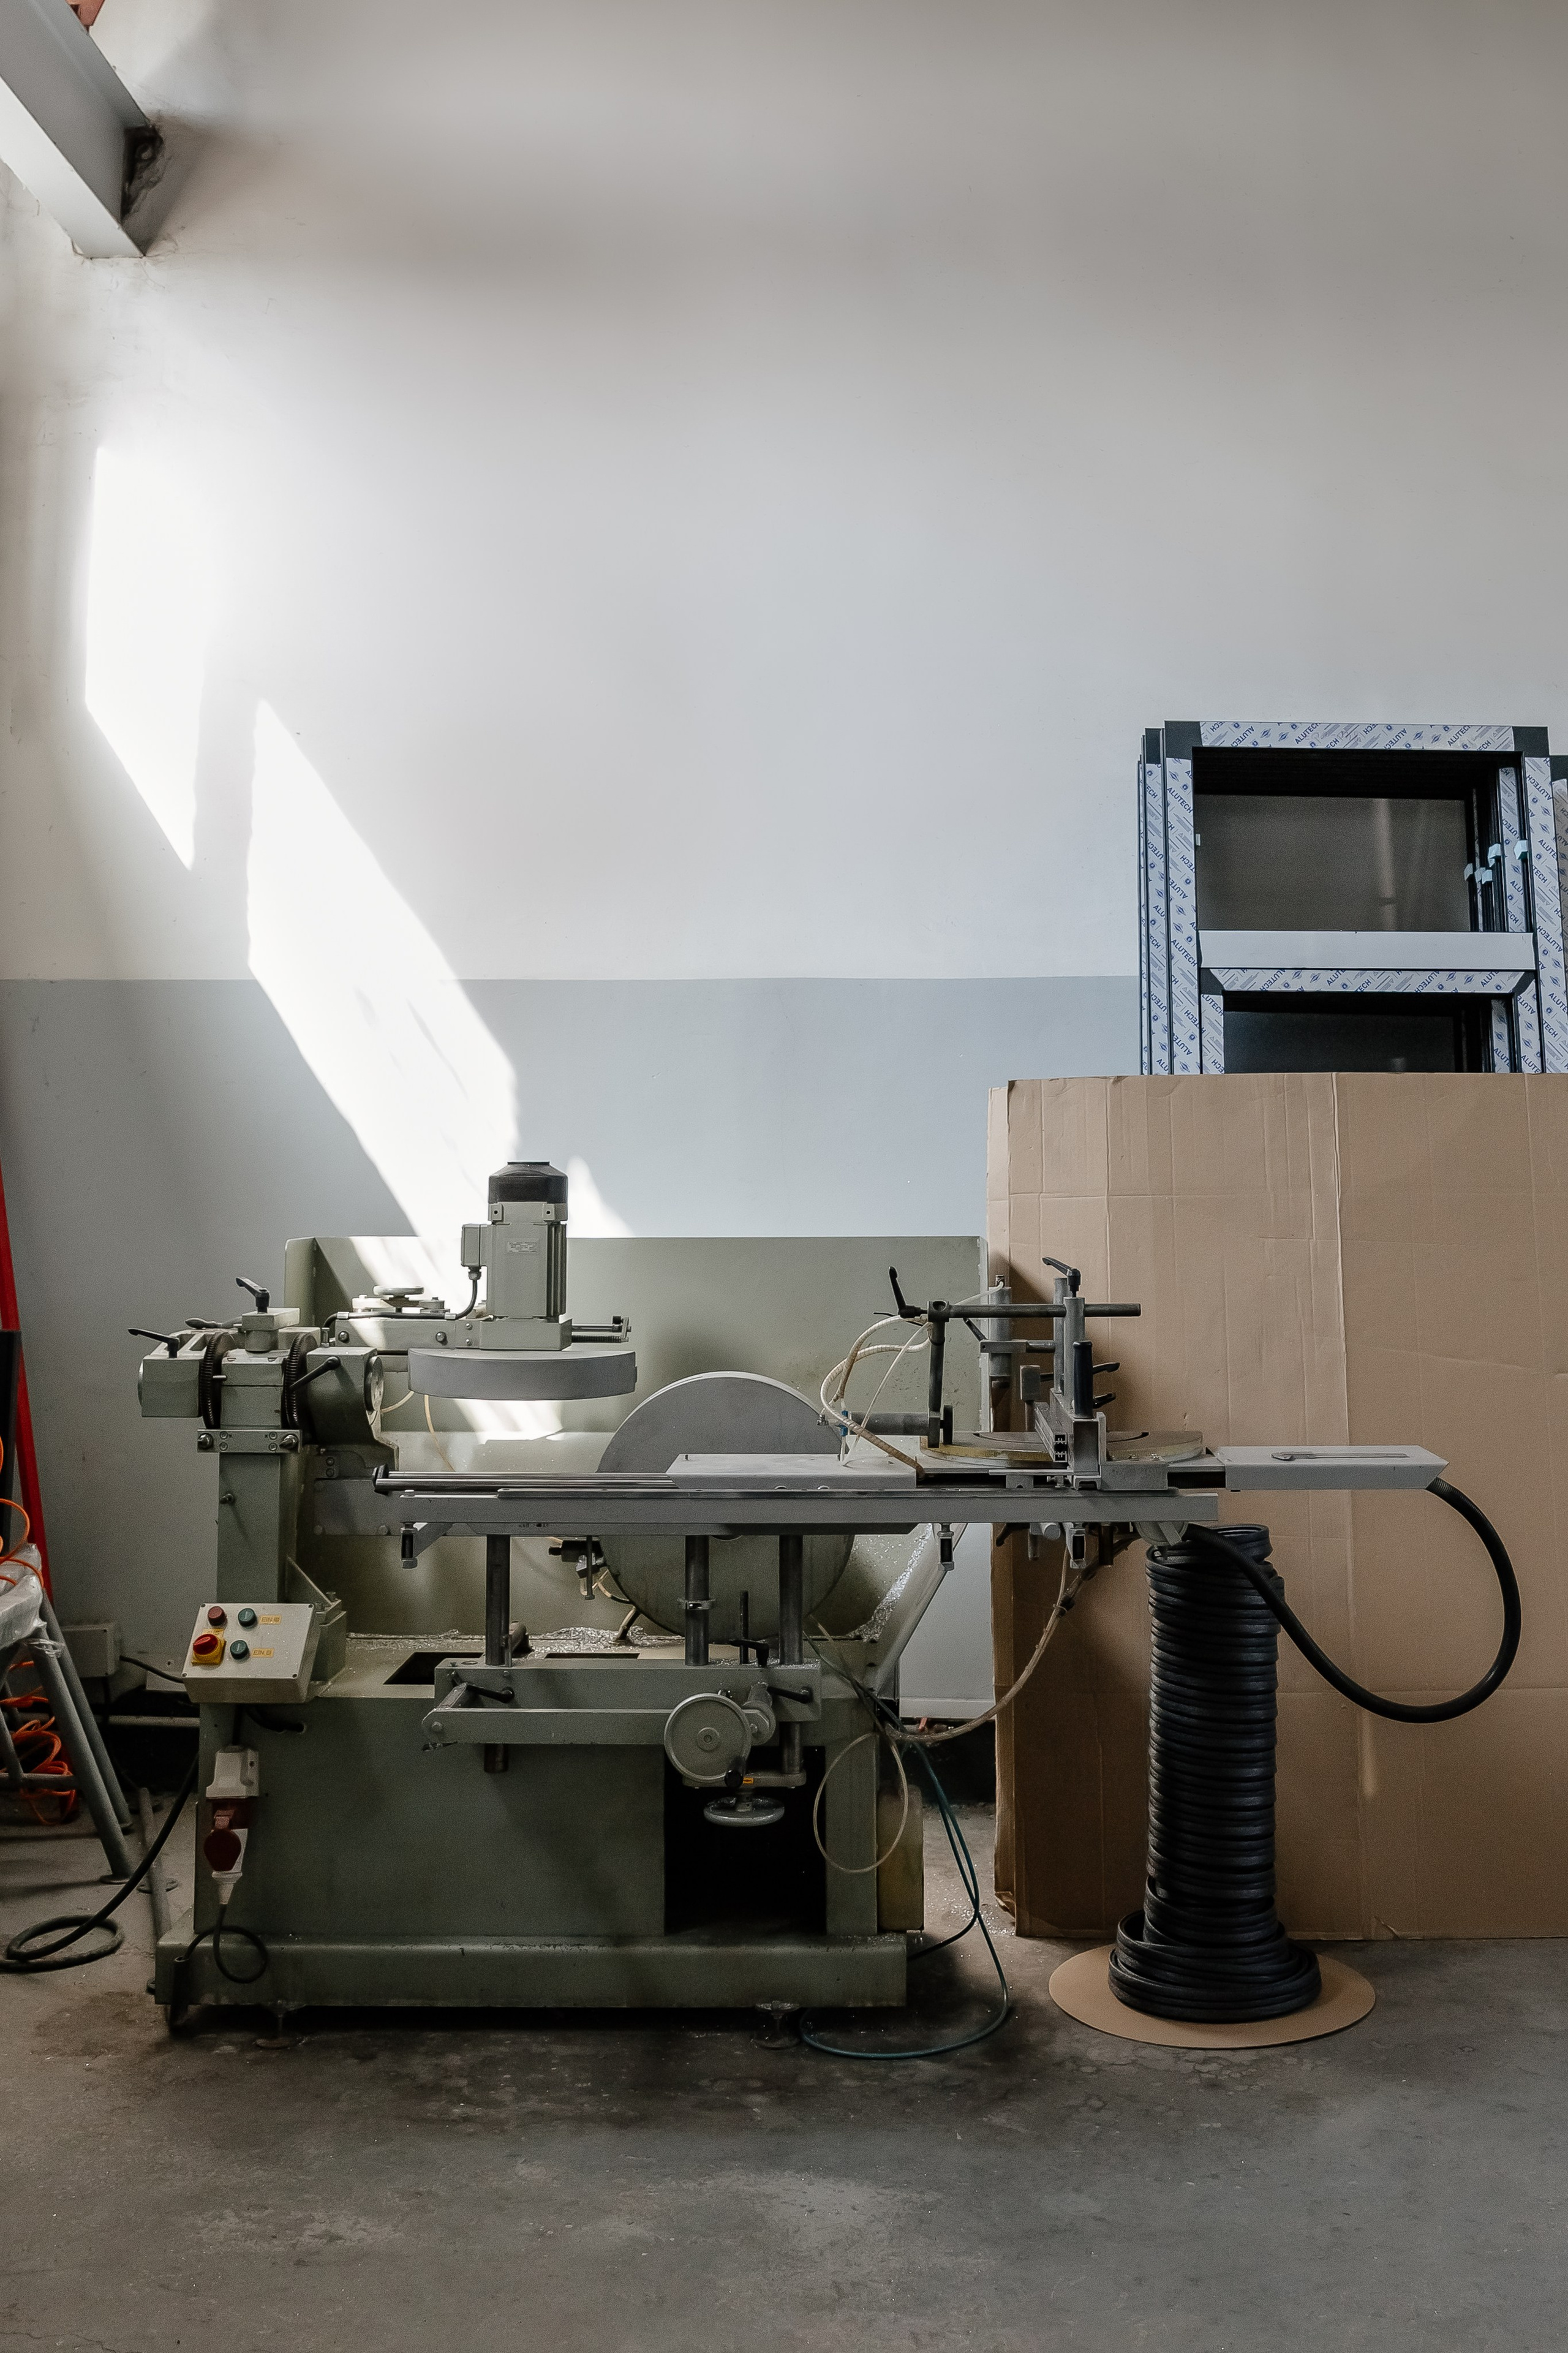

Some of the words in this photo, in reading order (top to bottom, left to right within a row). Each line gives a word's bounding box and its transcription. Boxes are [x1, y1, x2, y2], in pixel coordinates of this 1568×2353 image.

[1167, 787, 1193, 813] ALUTECH
[1526, 774, 1553, 801] ALUTECH
[1537, 926, 1562, 952] ALUTECH
[1171, 939, 1197, 967] ALUTECH
